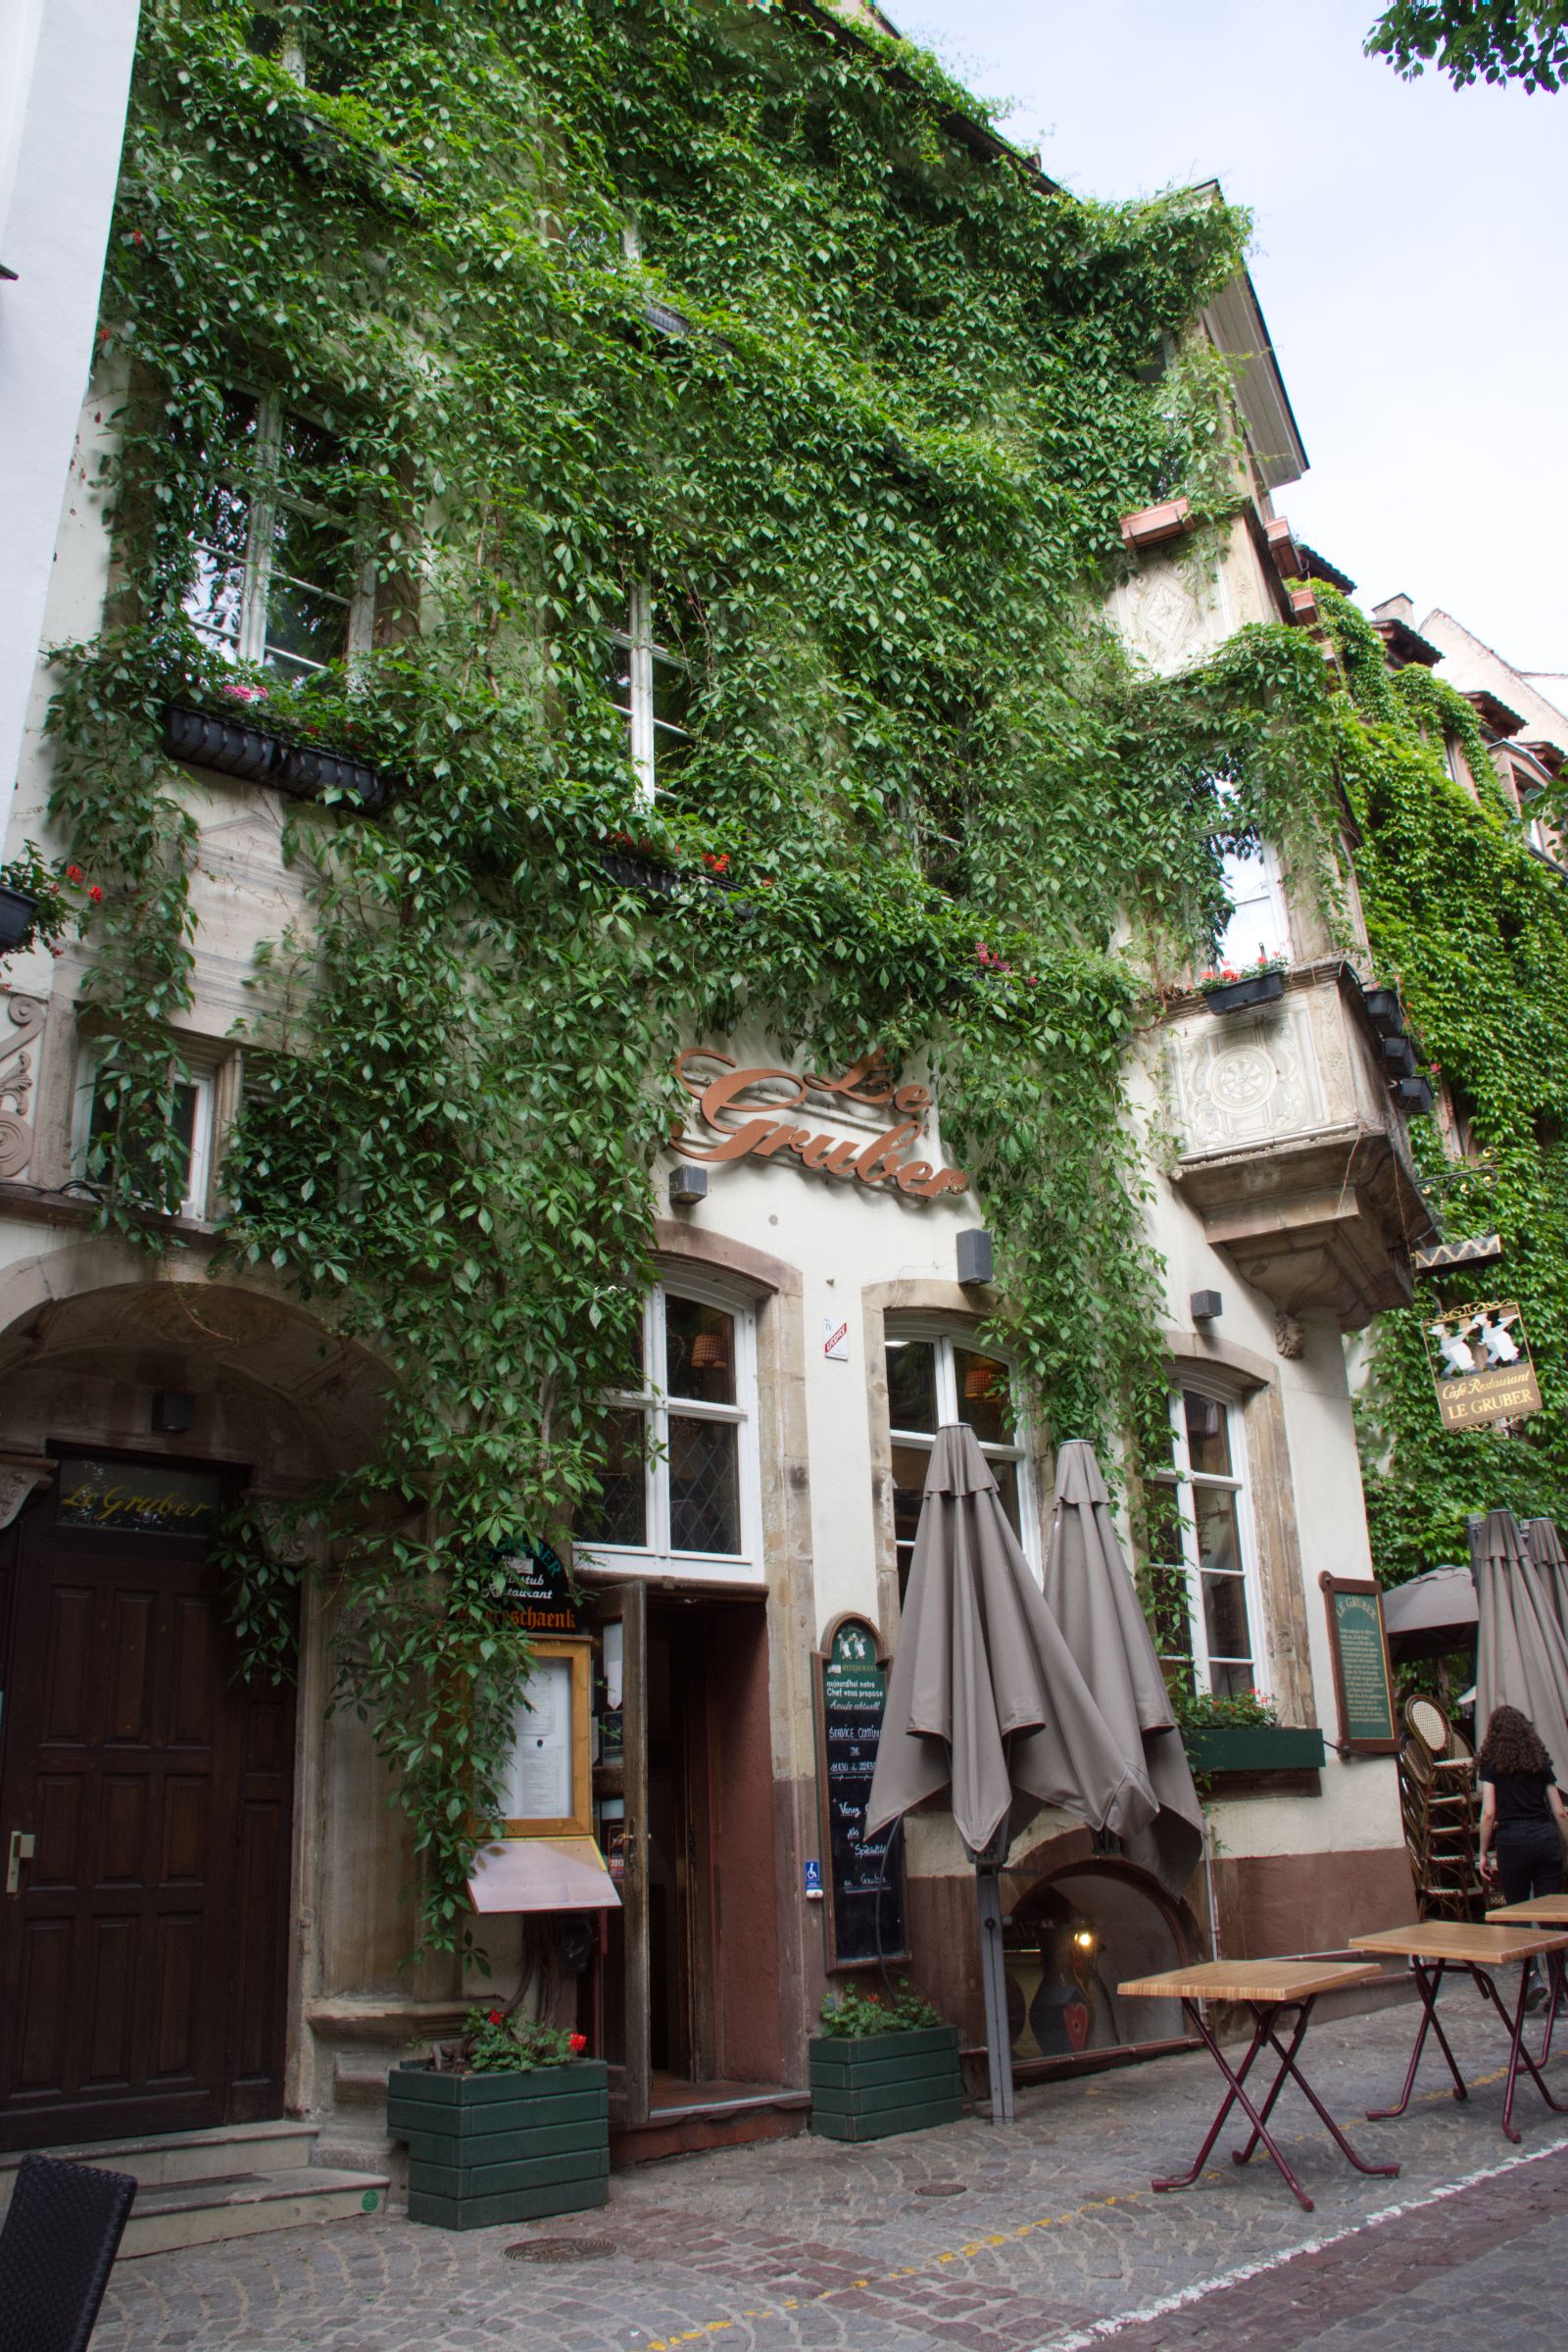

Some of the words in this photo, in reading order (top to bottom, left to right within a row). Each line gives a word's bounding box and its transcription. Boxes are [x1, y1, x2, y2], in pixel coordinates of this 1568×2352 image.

[802, 1045, 934, 1114] Le
[668, 1047, 970, 1199] Gruber
[1443, 1380, 1467, 1401] Café
[1467, 1370, 1531, 1396] Restaurant
[1446, 1403, 1469, 1420] LE
[1471, 1388, 1535, 1414] GRUBER
[61, 1483, 100, 1508] Le
[95, 1485, 212, 1522] Gruber
[1336, 1601, 1347, 1618] LE
[1346, 1596, 1376, 1621] GRUBER
[826, 1688, 842, 1697] Chef
[858, 1690, 884, 1698] propose
[830, 1699, 853, 1710] heute
[854, 1700, 881, 1710] aktuell
[839, 1801, 861, 1818] Venez
